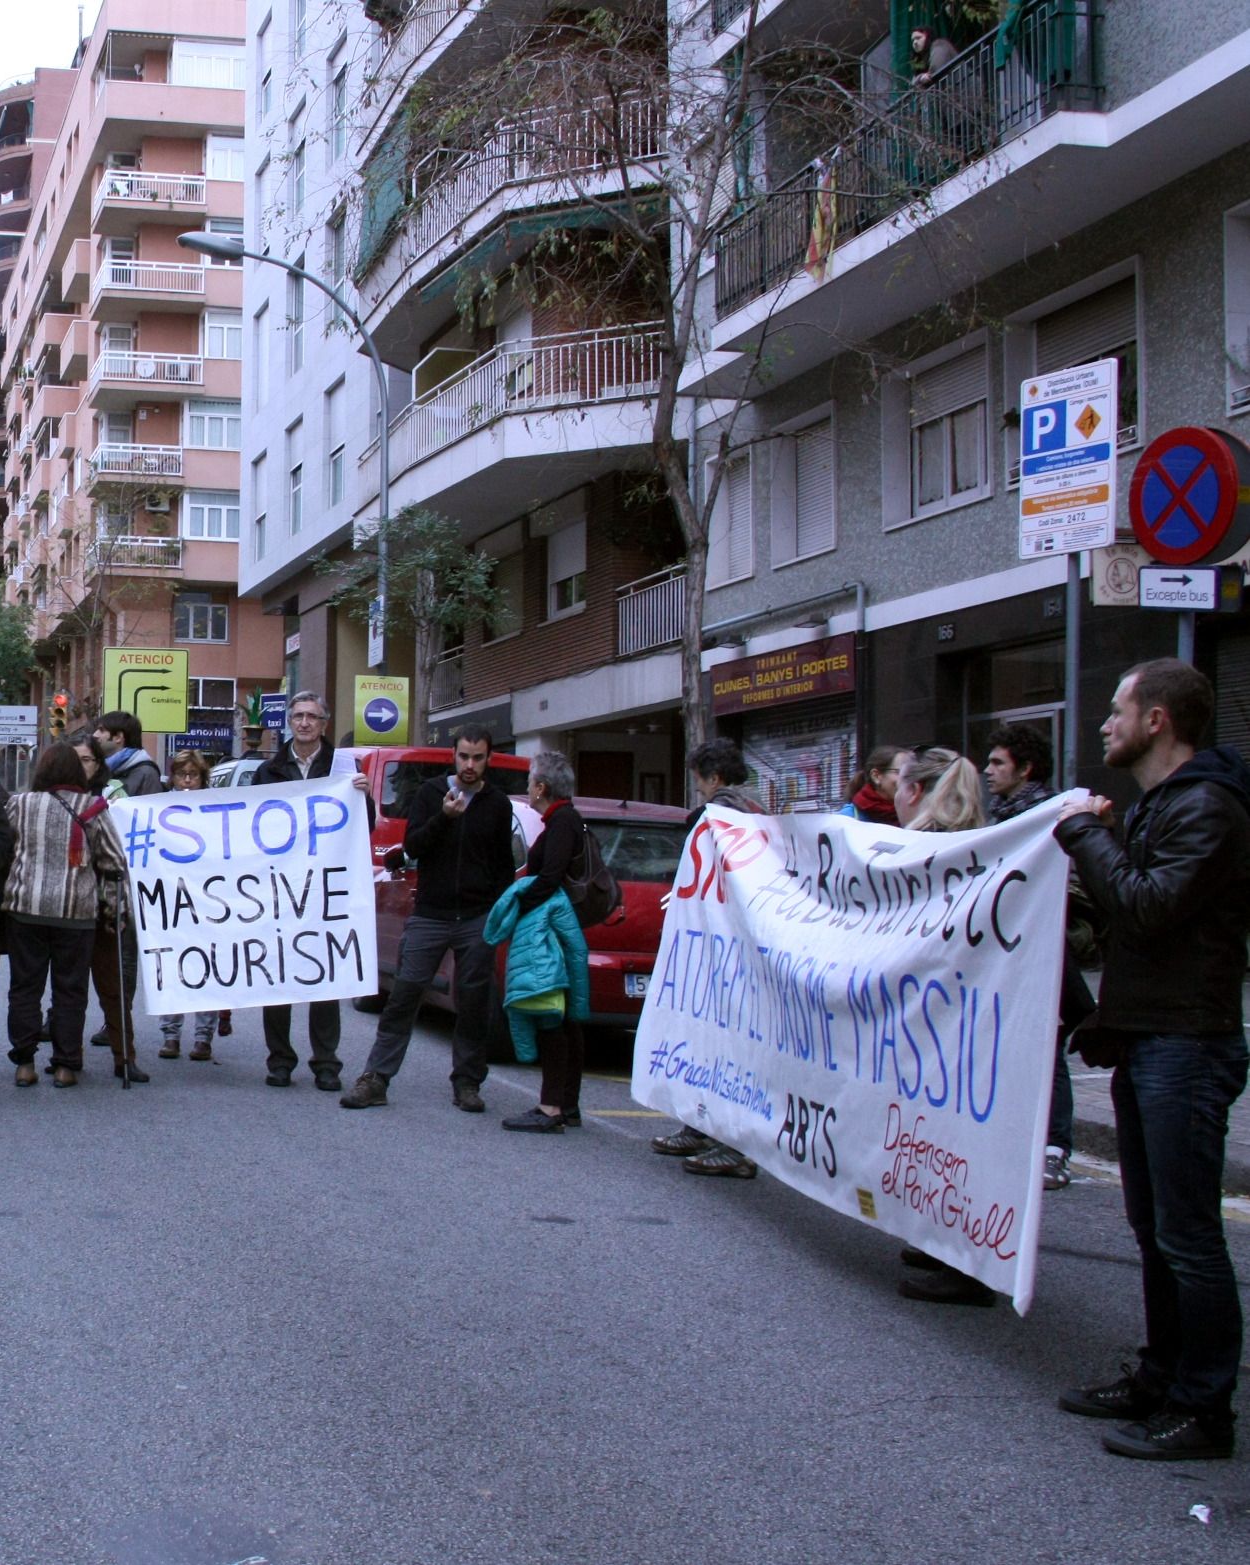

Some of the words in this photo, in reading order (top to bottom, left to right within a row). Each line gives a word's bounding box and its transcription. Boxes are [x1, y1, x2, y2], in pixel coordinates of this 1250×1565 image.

[1032, 408, 1056, 450] P
[1067, 512, 1086, 524] 2472
[1146, 588, 1186, 603] Excepte
[1189, 590, 1209, 602] bus
[119, 653, 174, 665] ATENCIÓ
[756, 667, 794, 687] BANYS
[802, 655, 848, 676] PORTES
[360, 682, 404, 692] ATENCIÓ
[267, 718, 282, 727] taxi
[125, 795, 349, 868] #STOP
[777, 1093, 837, 1178] ABTS
[884, 1103, 968, 1187] Defensem
[882, 1152, 902, 1199] el
[903, 1165, 940, 1225] Park
[941, 1184, 1016, 1260] Güell
